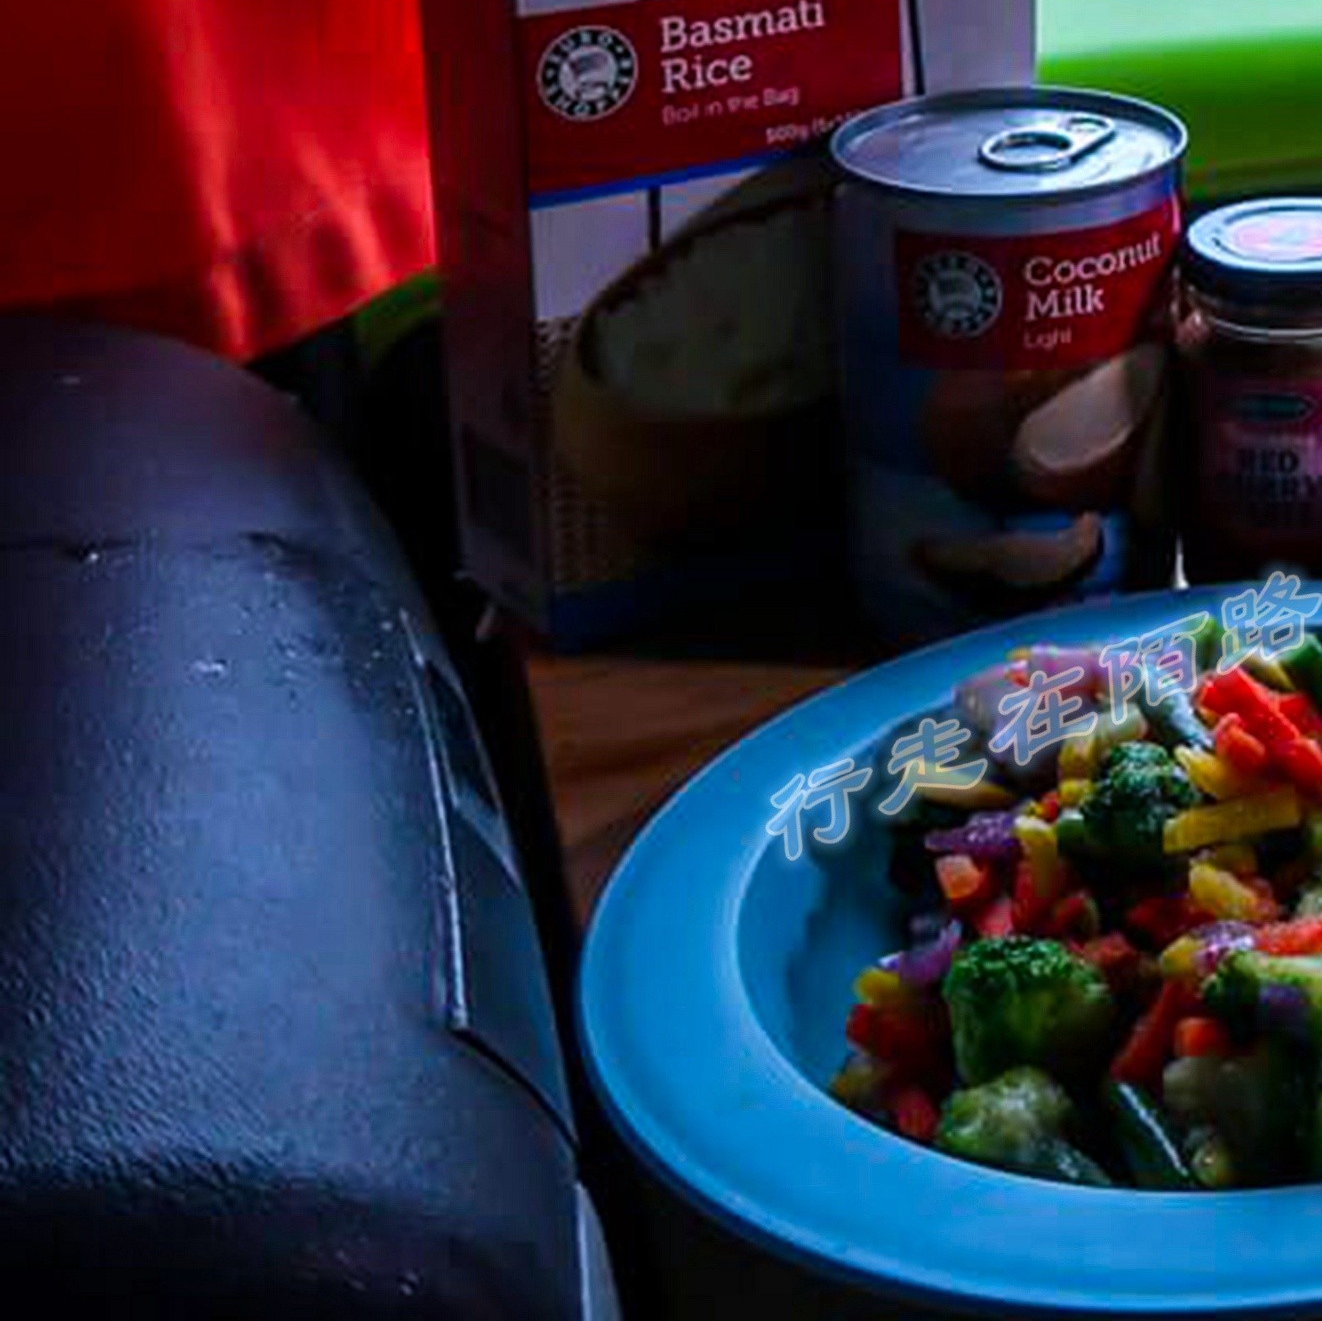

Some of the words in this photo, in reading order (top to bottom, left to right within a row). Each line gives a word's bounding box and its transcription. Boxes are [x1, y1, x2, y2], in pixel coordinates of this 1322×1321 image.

[661, 54, 753, 94] Rice
[1023, 230, 1162, 287] Coconut
[1025, 283, 1105, 323] Milk
